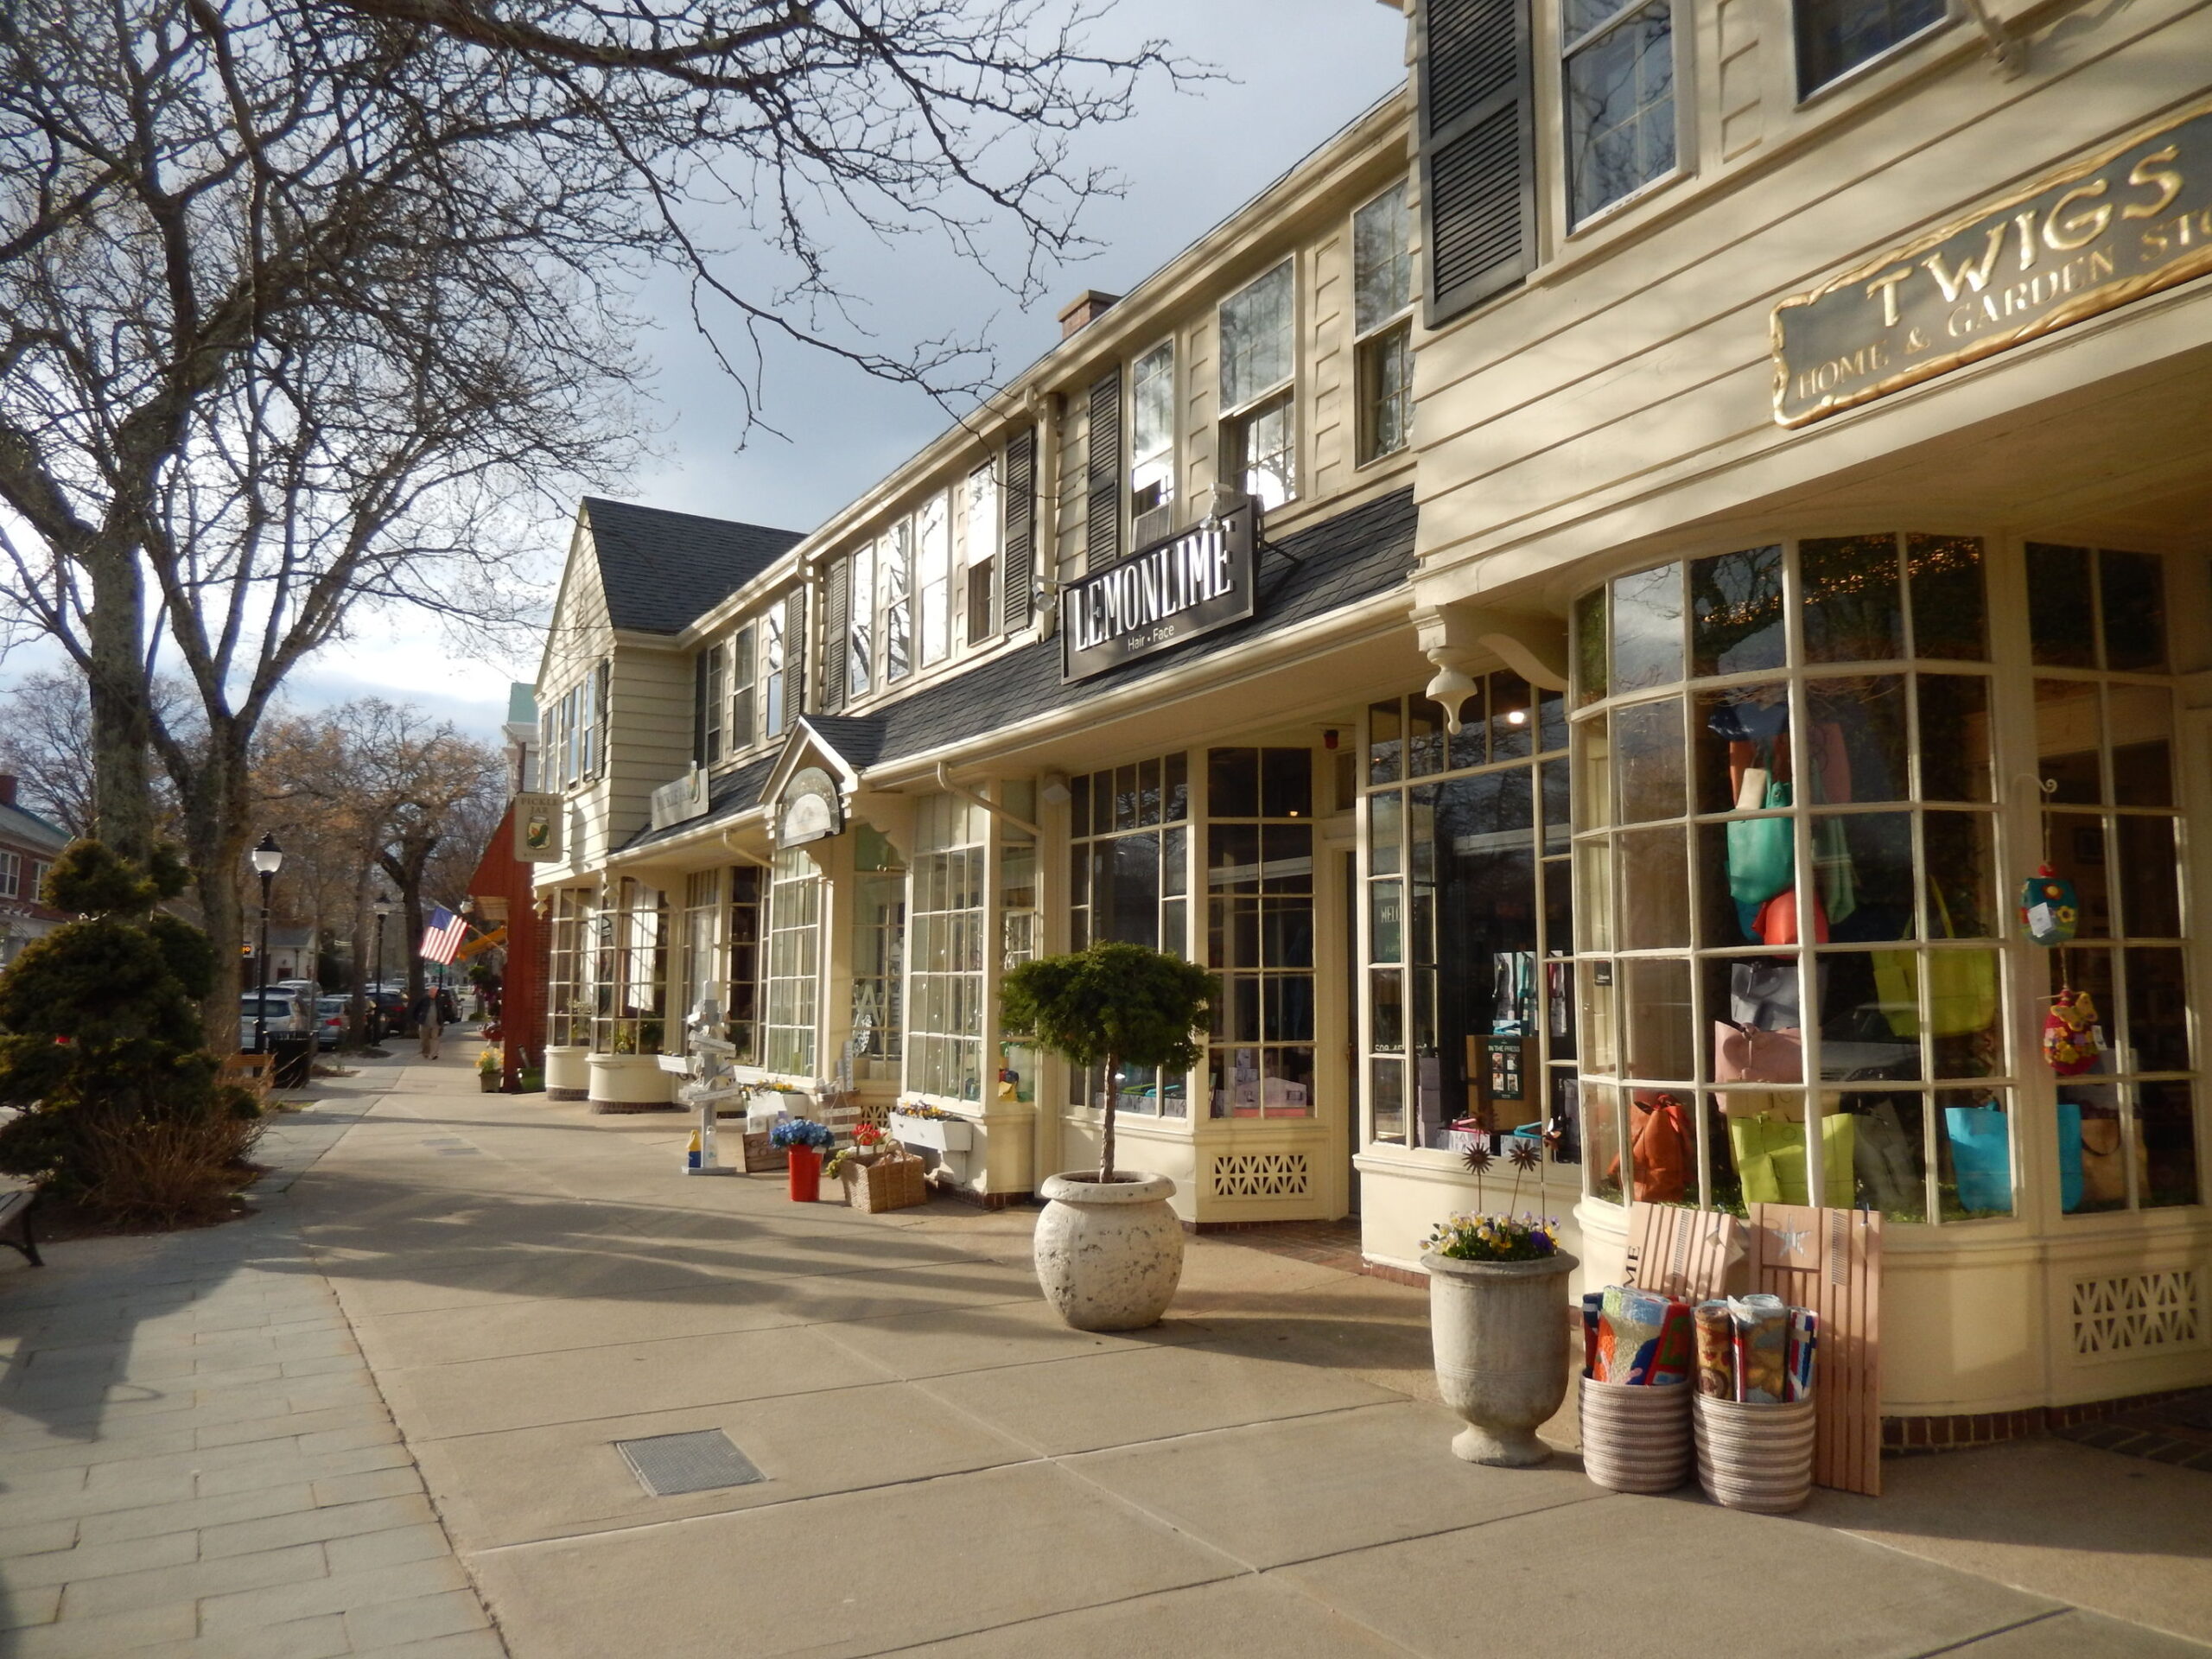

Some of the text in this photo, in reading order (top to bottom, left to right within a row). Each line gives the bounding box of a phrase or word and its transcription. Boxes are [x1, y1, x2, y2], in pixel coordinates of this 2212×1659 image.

[1866, 144, 2183, 327] TWIGS
[1797, 339, 1890, 399] HOME
[1904, 327, 1931, 354] &
[1948, 245, 2115, 338] GARDEN
[1073, 519, 1234, 652] LEMONLIME
[1128, 624, 1175, 652] Hair Face
